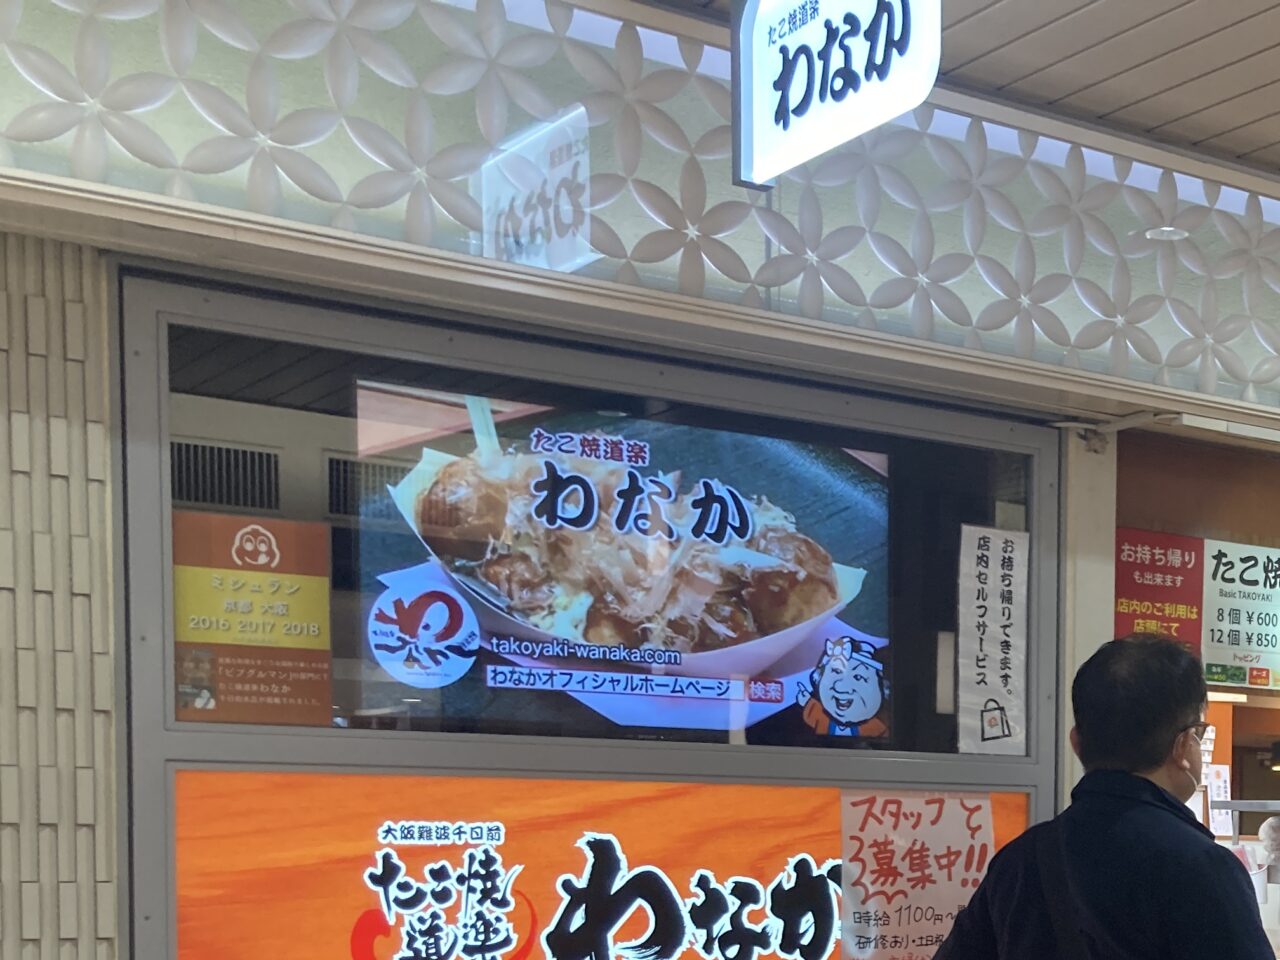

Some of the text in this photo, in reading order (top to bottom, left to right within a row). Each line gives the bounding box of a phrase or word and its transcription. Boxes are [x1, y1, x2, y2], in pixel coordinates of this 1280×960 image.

[773, 0, 911, 131] わなか
[531, 428, 650, 466] たこ焼道楽
[532, 460, 752, 545] わなか
[1120, 542, 1196, 568] お持ち帰り
[211, 574, 301, 595] ミシュラン
[1133, 571, 1184, 587] も出来ます
[1218, 588, 1273, 602] Basic TAKOYAKI
[975, 535, 991, 686] 店内セルフサービス
[1000, 538, 1015, 696] お持ち帰りできます。
[1117, 598, 1199, 620] 店内のご利用は
[188, 615, 321, 636] 2016 2017 2018
[490, 637, 681, 666] takoyaki-wanaka.com
[490, 667, 732, 697] わなかオフィシャルホームページ
[749, 681, 782, 701] 検索
[379, 822, 504, 844] 大阪難波千日前
